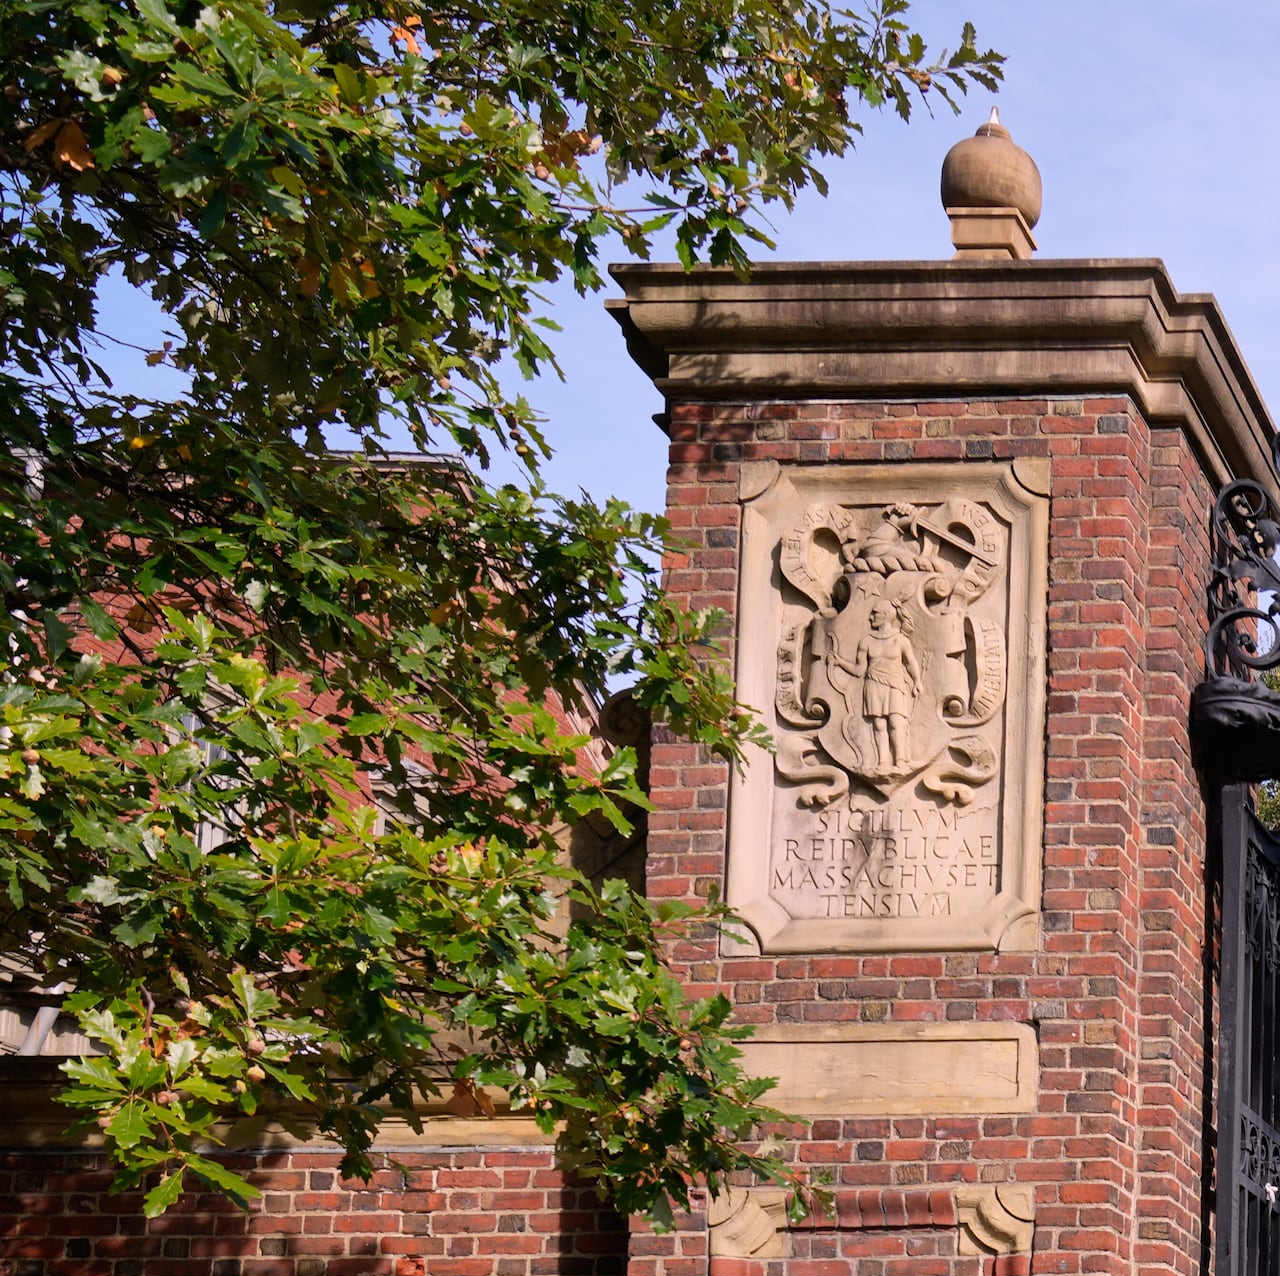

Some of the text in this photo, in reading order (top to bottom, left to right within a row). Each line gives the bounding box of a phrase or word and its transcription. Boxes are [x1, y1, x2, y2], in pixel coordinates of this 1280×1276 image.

[972, 621, 1001, 719] LIBERTATE
[816, 809, 958, 833] SIGILLVM
[785, 836, 993, 861] REIPVBLICAE
[774, 864, 1000, 889] MASSACHVSET
[819, 892, 952, 916] TENSIVM
